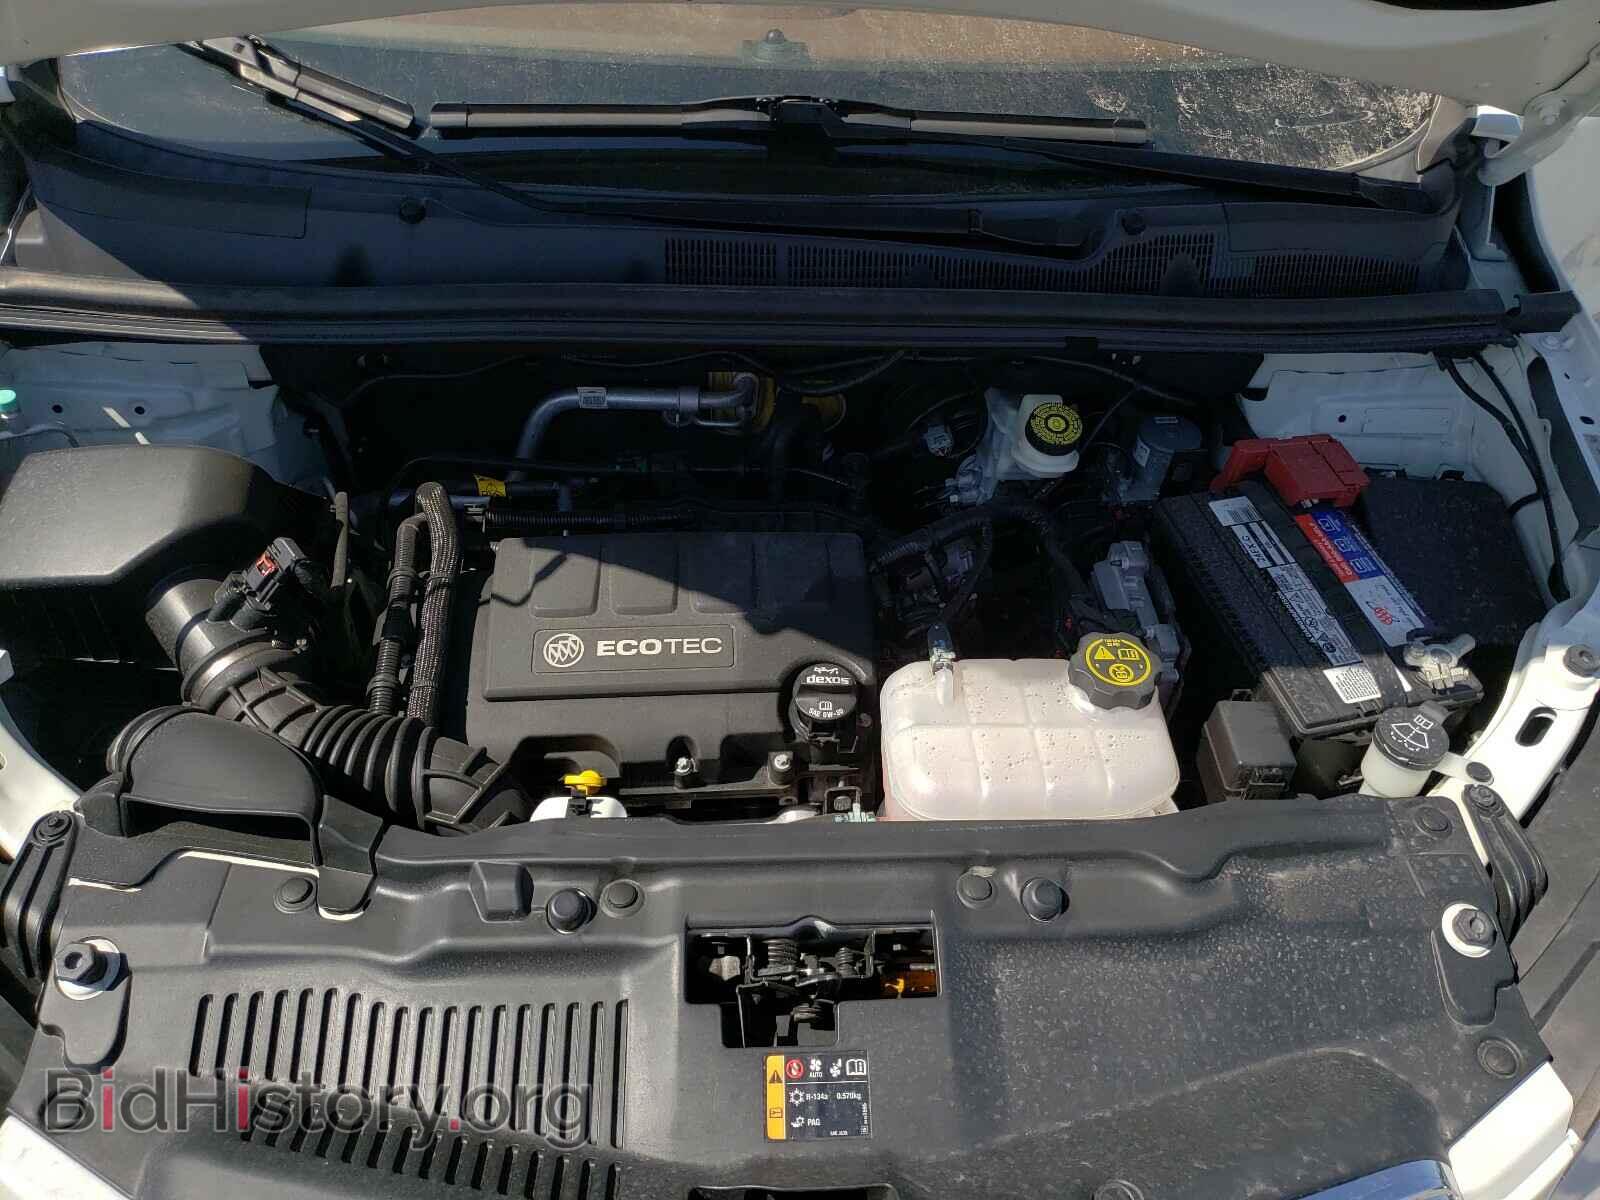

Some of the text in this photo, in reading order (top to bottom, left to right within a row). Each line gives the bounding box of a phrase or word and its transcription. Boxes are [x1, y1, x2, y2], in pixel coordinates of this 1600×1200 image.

[596, 637, 722, 656] ECOTEC
[806, 675, 850, 685] dexos
[807, 1118, 821, 1126] PAG
